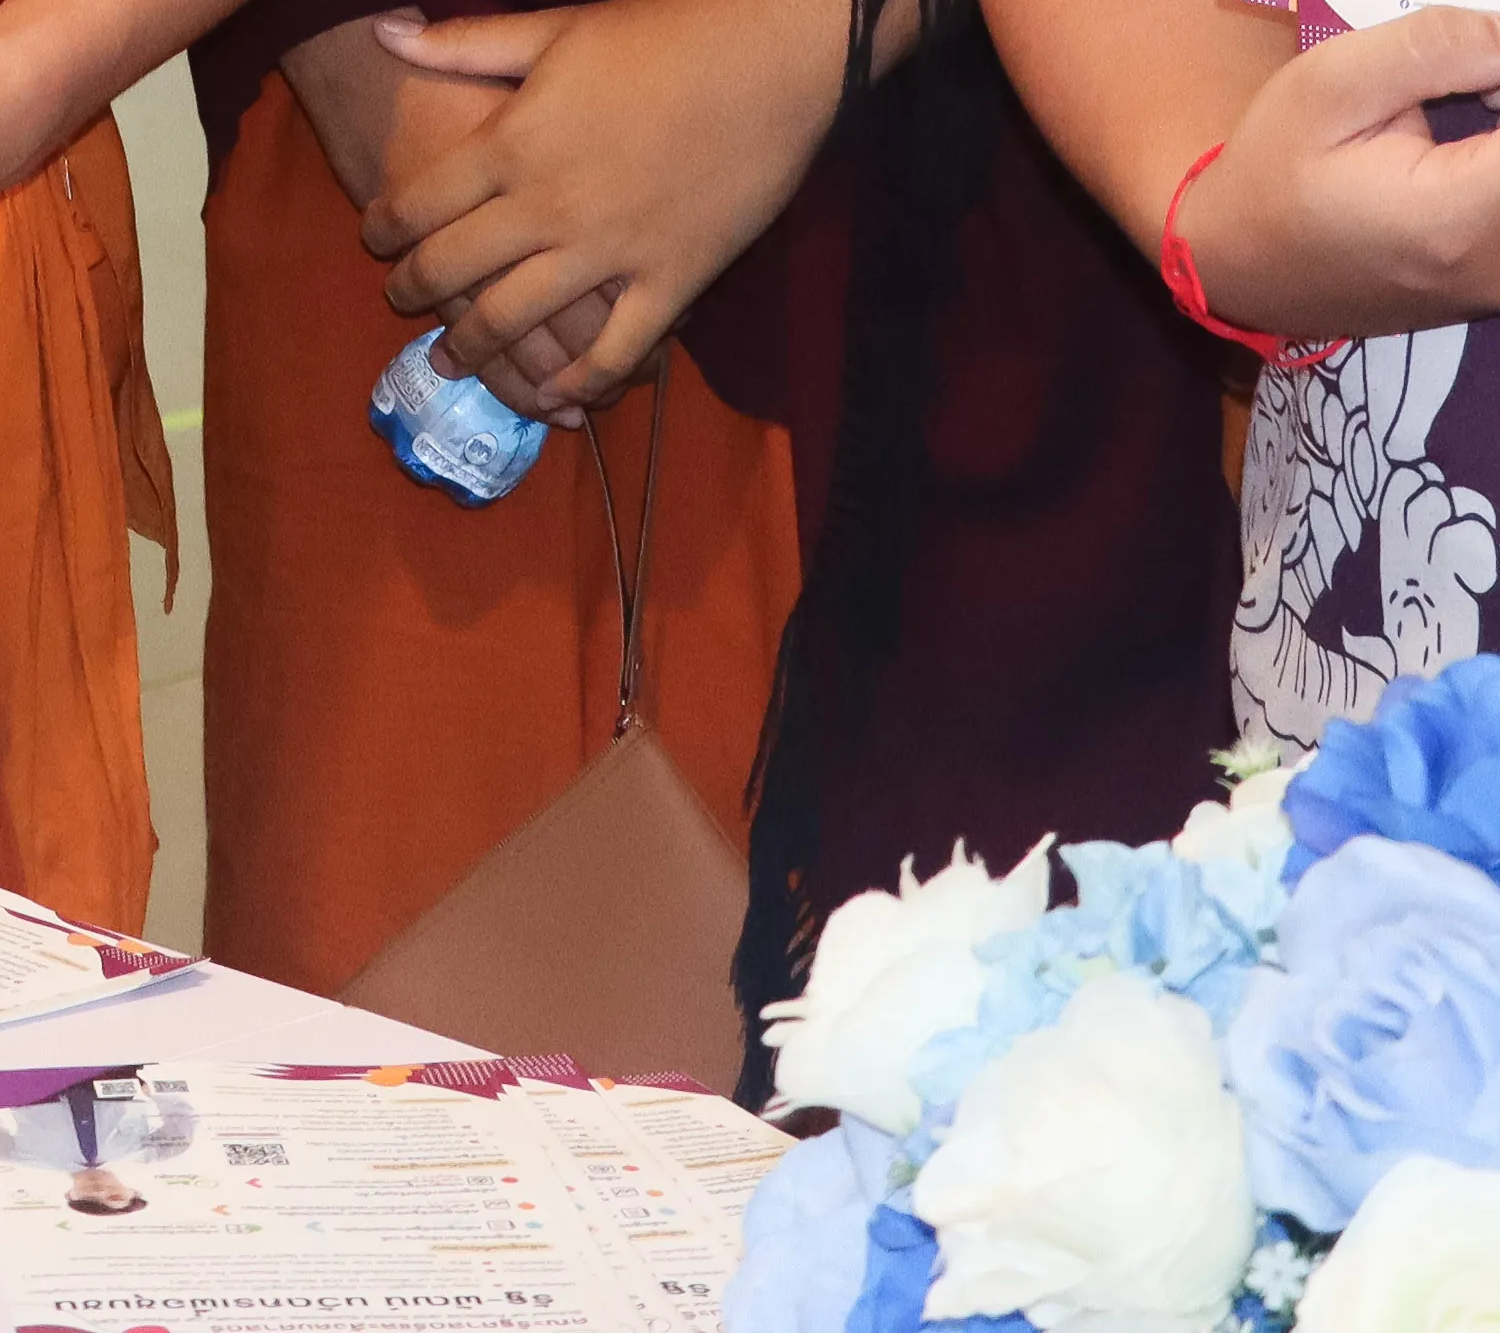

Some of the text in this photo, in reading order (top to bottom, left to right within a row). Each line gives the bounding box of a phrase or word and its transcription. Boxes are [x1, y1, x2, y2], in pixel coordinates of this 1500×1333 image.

[54, 1289, 554, 1317] รัฐ-พัฒน์ นวัตกรเพื่อชุมชน
